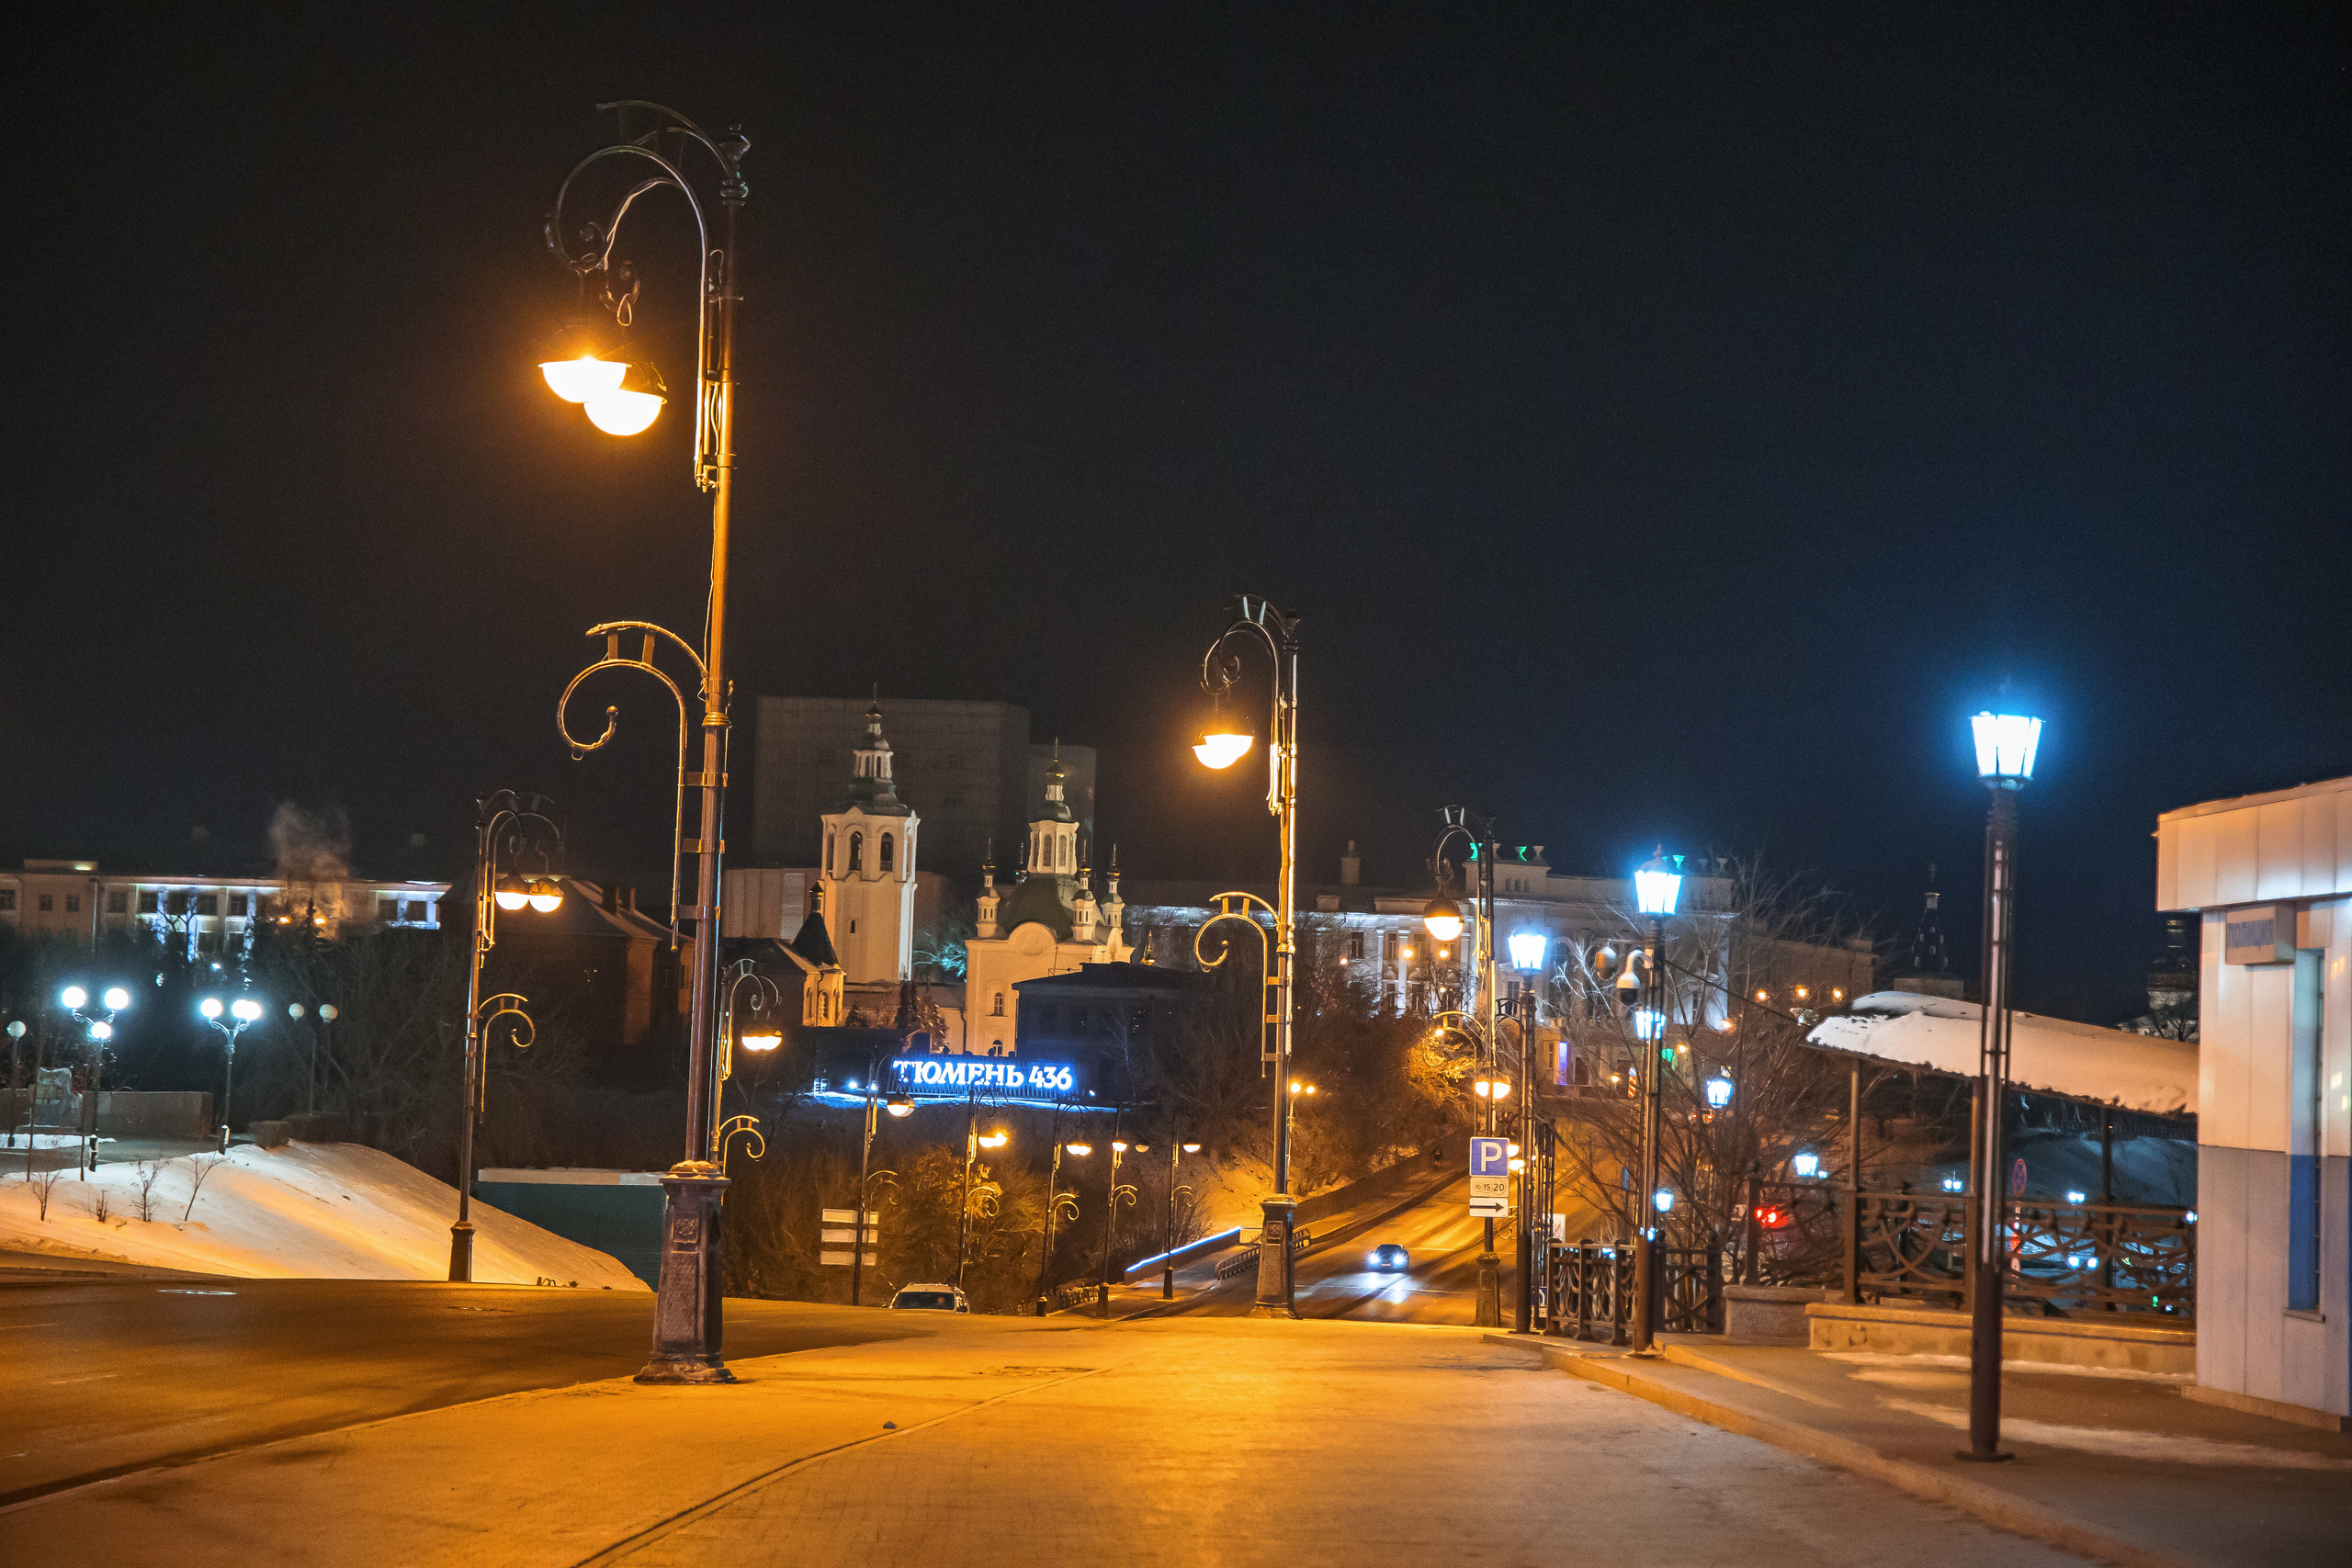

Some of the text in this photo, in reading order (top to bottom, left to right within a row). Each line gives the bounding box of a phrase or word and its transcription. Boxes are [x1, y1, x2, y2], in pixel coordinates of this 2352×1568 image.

[893, 1060, 1072, 1090] ТЮМЕНЬ 436
[1481, 1141, 1502, 1171] P
[1493, 1183, 1505, 1191] 20
